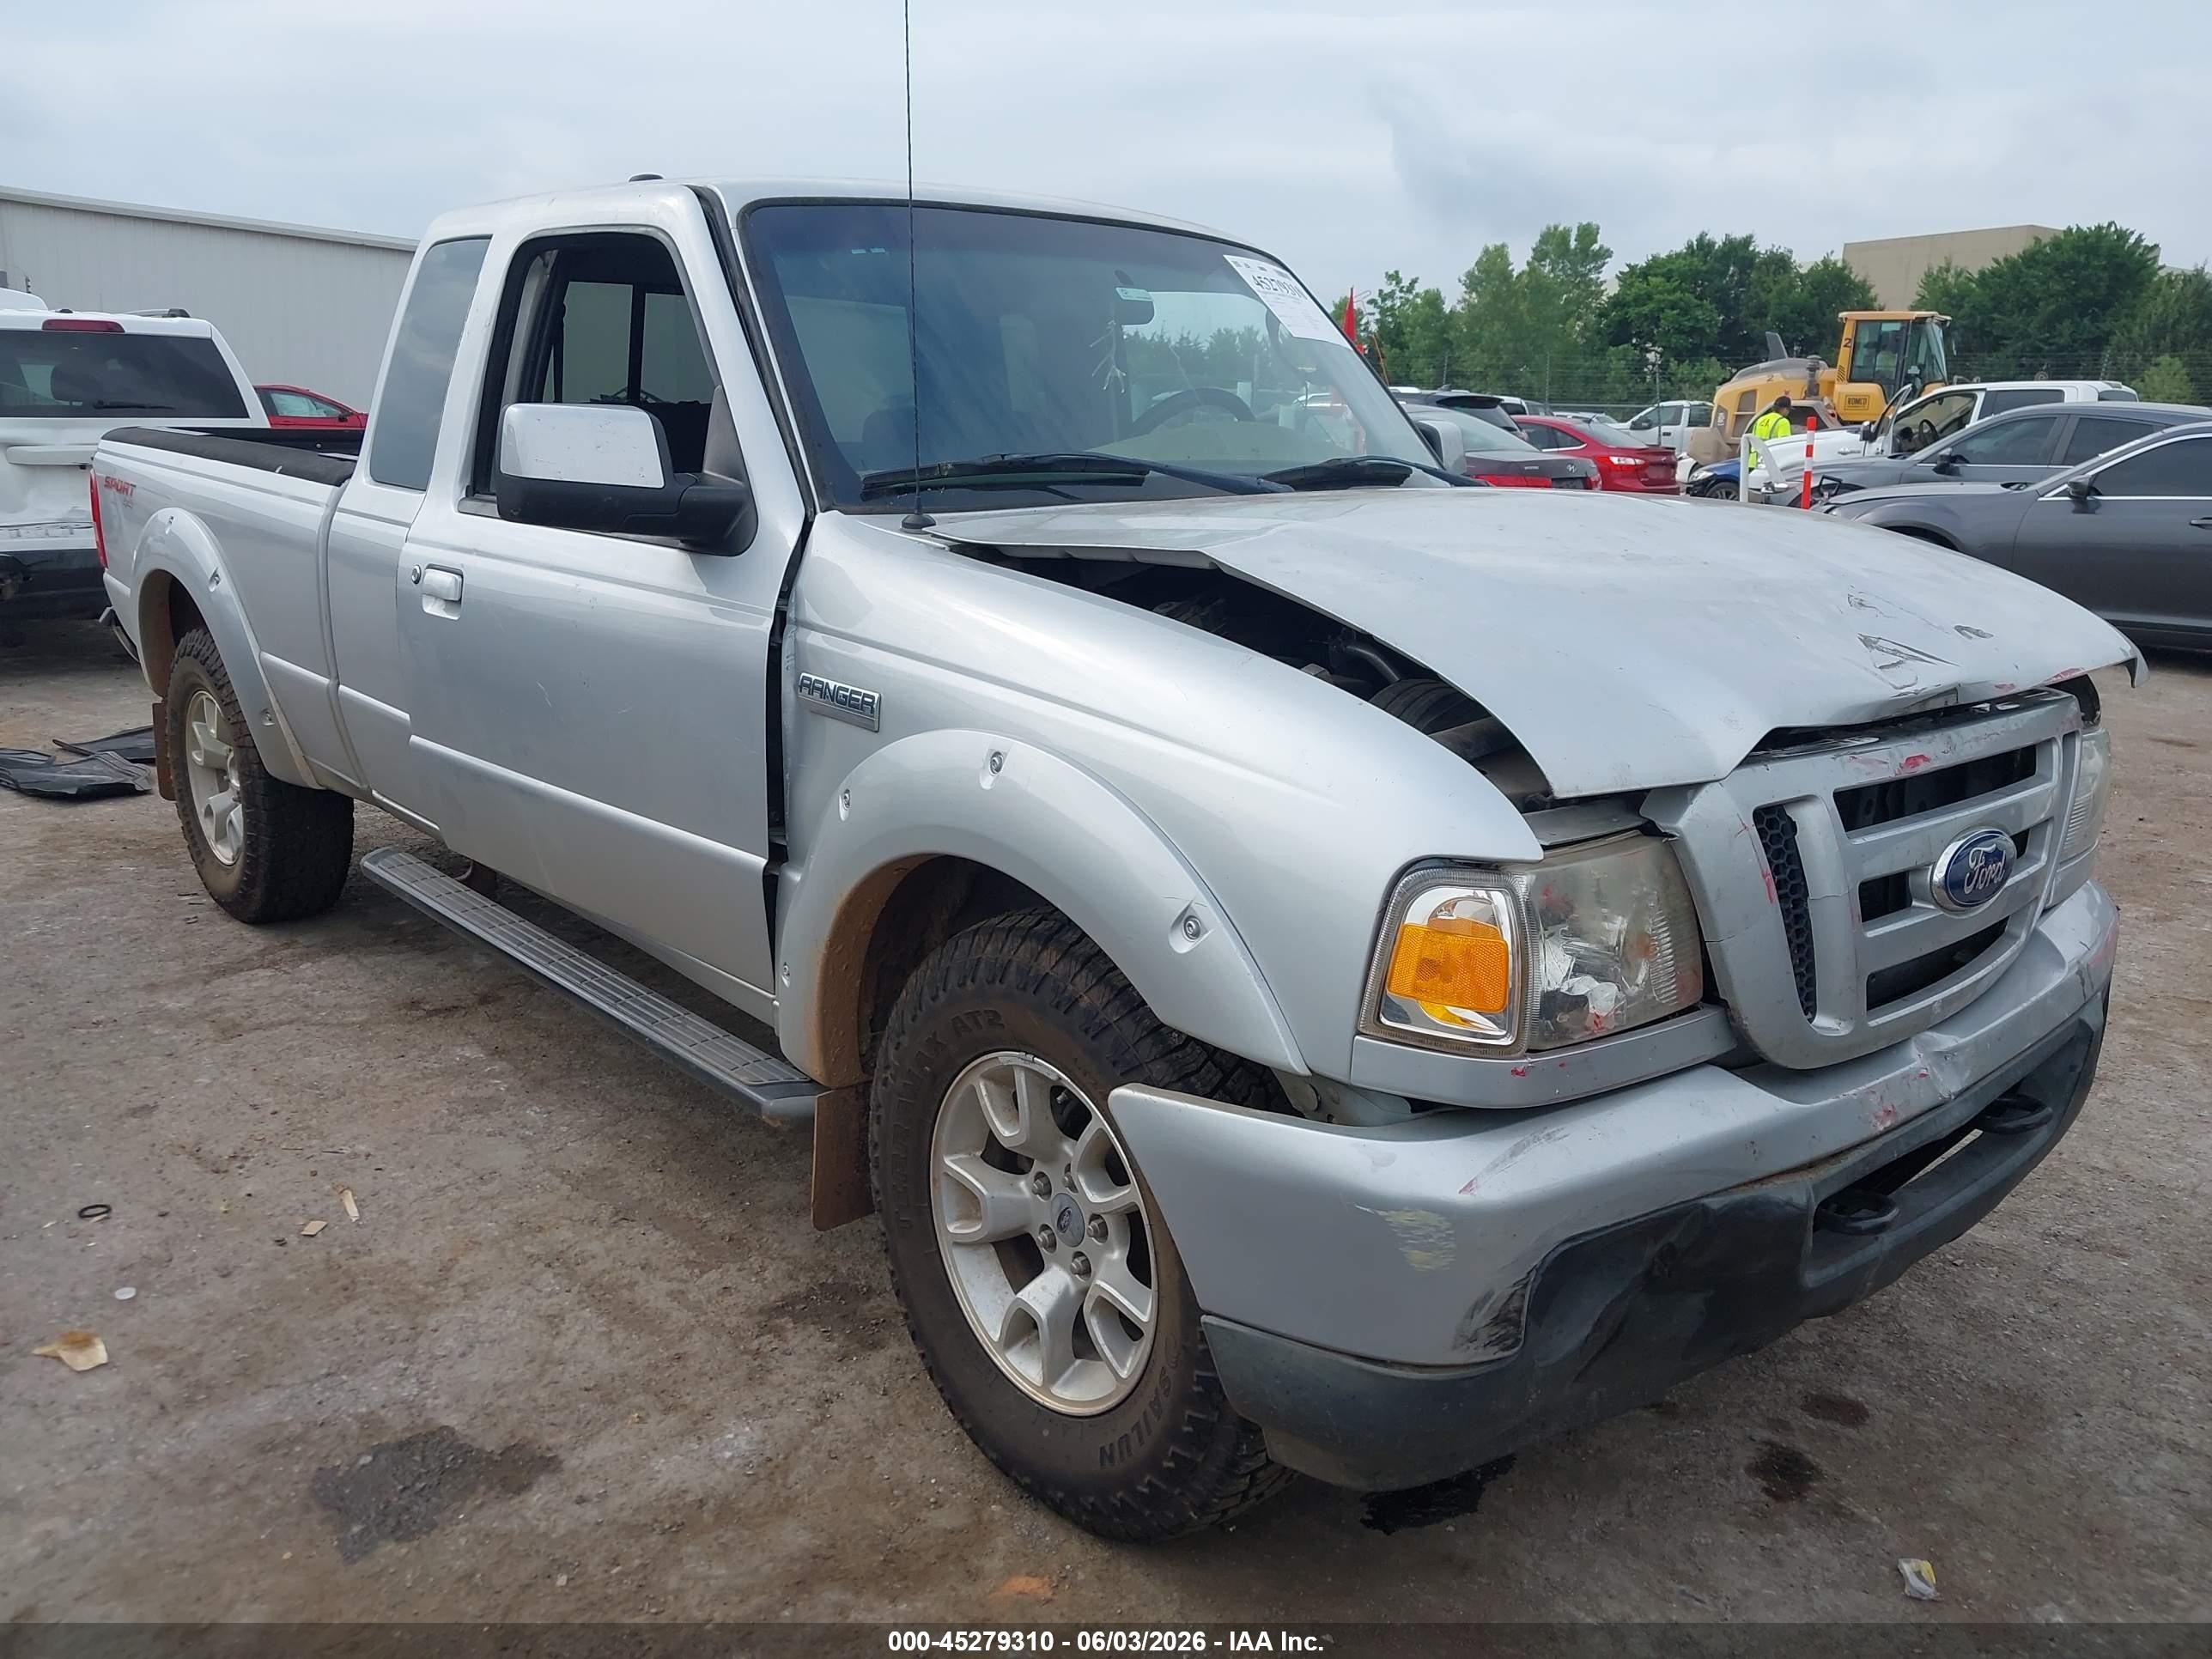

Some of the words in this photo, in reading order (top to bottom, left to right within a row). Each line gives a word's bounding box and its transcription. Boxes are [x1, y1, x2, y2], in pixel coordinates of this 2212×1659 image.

[1843, 337, 1851, 348] 2
[104, 476, 137, 496] SPORT
[799, 676, 876, 714] RANGER
[1964, 843, 2006, 895] Ford
[950, 1009, 1006, 1037] AT2
[1098, 1366, 1172, 1469] SAILUN
